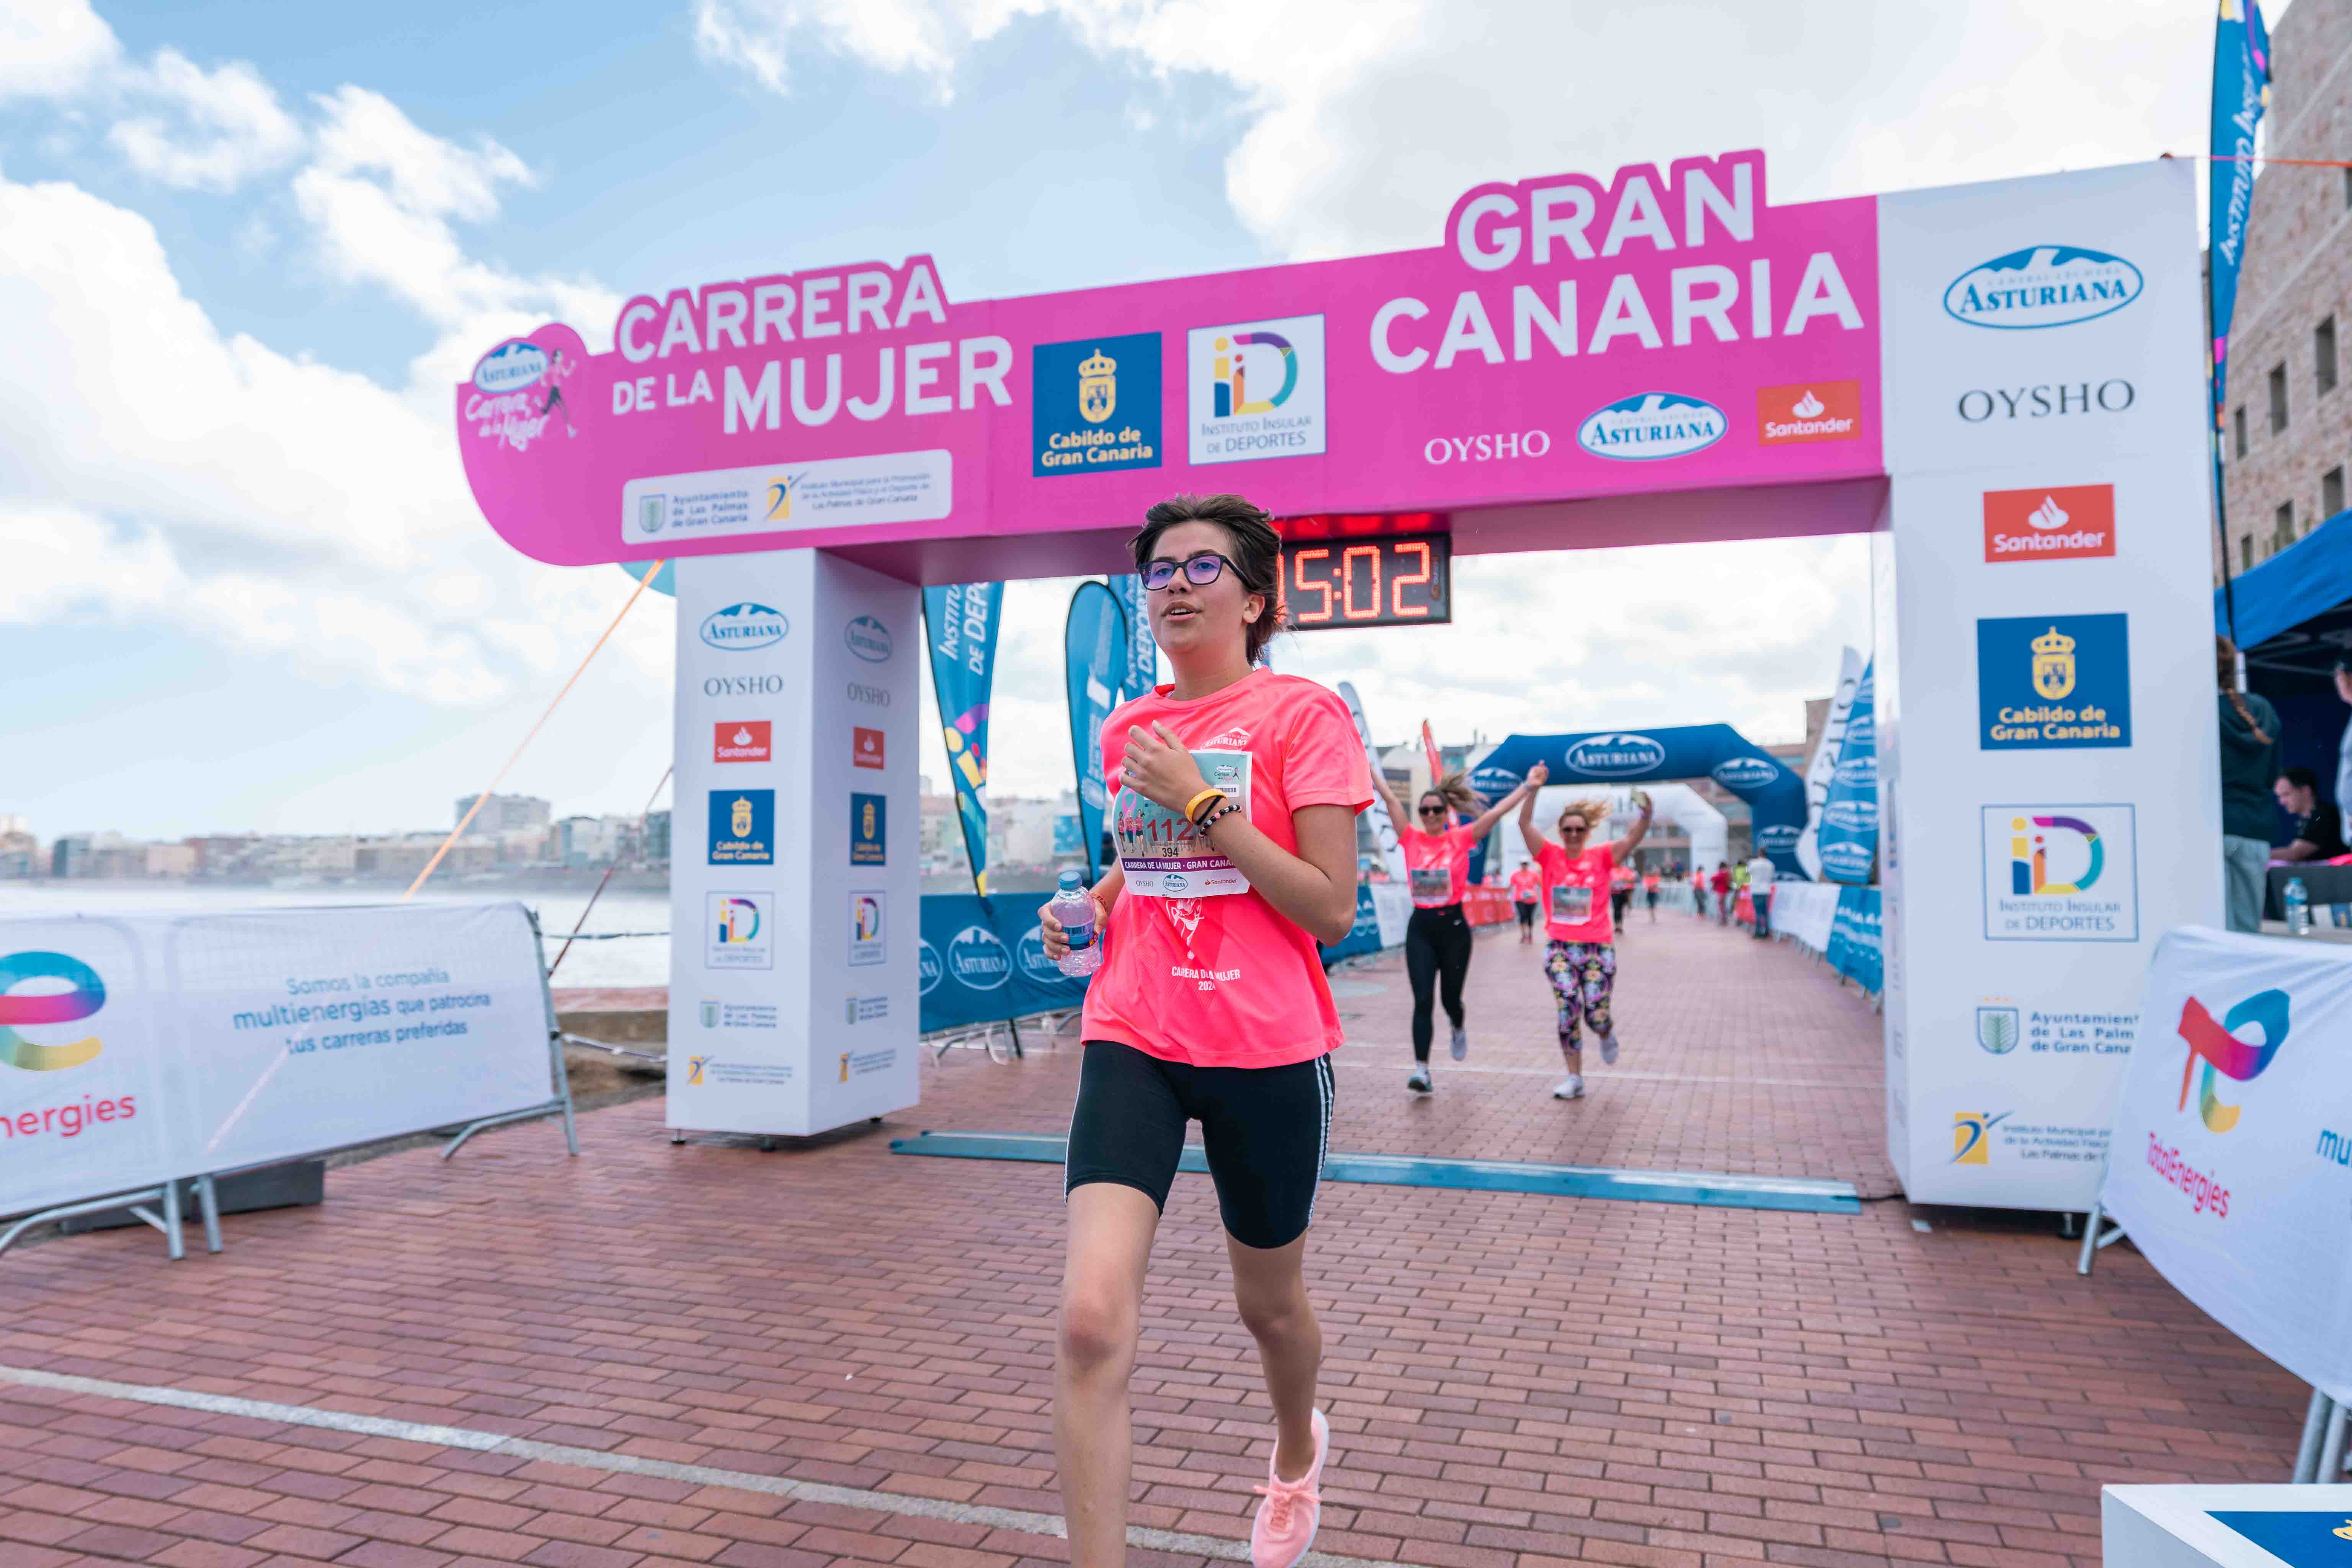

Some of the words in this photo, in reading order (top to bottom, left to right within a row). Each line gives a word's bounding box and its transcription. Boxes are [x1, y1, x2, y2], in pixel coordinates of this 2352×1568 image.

[1457, 163, 1753, 271] GRAN
[1960, 279, 2128, 314] ASTURIANA
[619, 264, 946, 363] CARRERA
[1370, 252, 1865, 373] CANARIA
[613, 379, 655, 415] DE
[667, 375, 714, 408] LA
[724, 335, 1013, 434] MUJER
[1958, 378, 2135, 423] OYSHO
[1202, 422, 1259, 436] INSTITUTO
[1263, 416, 1311, 430] INSULAR
[1591, 421, 1714, 446] ASTURIANA
[1765, 417, 1852, 438] Santander
[1050, 429, 1115, 449] Cabildo
[1119, 426, 1141, 443] de
[1225, 432, 1306, 452] DEPORTES
[1424, 430, 1550, 465] OYSHO
[1042, 451, 1083, 467] Gran
[1086, 443, 1153, 463] Canaria
[673, 490, 748, 505] Ayuntamiento
[673, 507, 684, 516] de
[690, 506, 706, 514] Las
[712, 503, 748, 512] Palmas
[673, 519, 683, 528] de
[685, 517, 707, 526] Gran
[711, 514, 748, 524] Canaria
[1993, 530, 2104, 553] Santander
[709, 624, 781, 639] ASTURIANA
[969, 648, 984, 677] DE
[704, 674, 783, 697] OYSHO
[846, 681, 890, 707] OYSHO
[1999, 706, 2076, 723] Cabildo
[2080, 705, 2106, 722] de
[1991, 725, 2038, 741] Gran
[2043, 723, 2120, 740] Canaria
[717, 746, 767, 759] Santander
[1575, 749, 1657, 766] ASTURIANA
[712, 851, 734, 861] Gran
[735, 851, 769, 860] Canaria
[716, 841, 749, 851] Cabildo
[752, 841, 764, 851] de
[1162, 847, 1179, 858] 394
[1125, 861, 1147, 869] CARRERA
[1162, 862, 1181, 870] MUJER
[1187, 860, 1208, 870] GRAN
[2000, 899, 2062, 913] INSTITUTO
[2068, 900, 2120, 913] INSULAR
[2026, 915, 2115, 931] DEPORTES
[287, 977, 350, 995] Somos
[356, 973, 370, 990] la
[397, 998, 424, 1014] que
[430, 993, 490, 1011] patrocina
[322, 1029, 390, 1050] carreras
[396, 1021, 467, 1044] preferidas
[2031, 1027, 2049, 1037] de
[2061, 1028, 2084, 1038] Las
[2031, 1041, 2049, 1052] de
[2053, 1042, 2089, 1053] Gran
[2148, 1131, 2230, 1219] TotalEnergies
